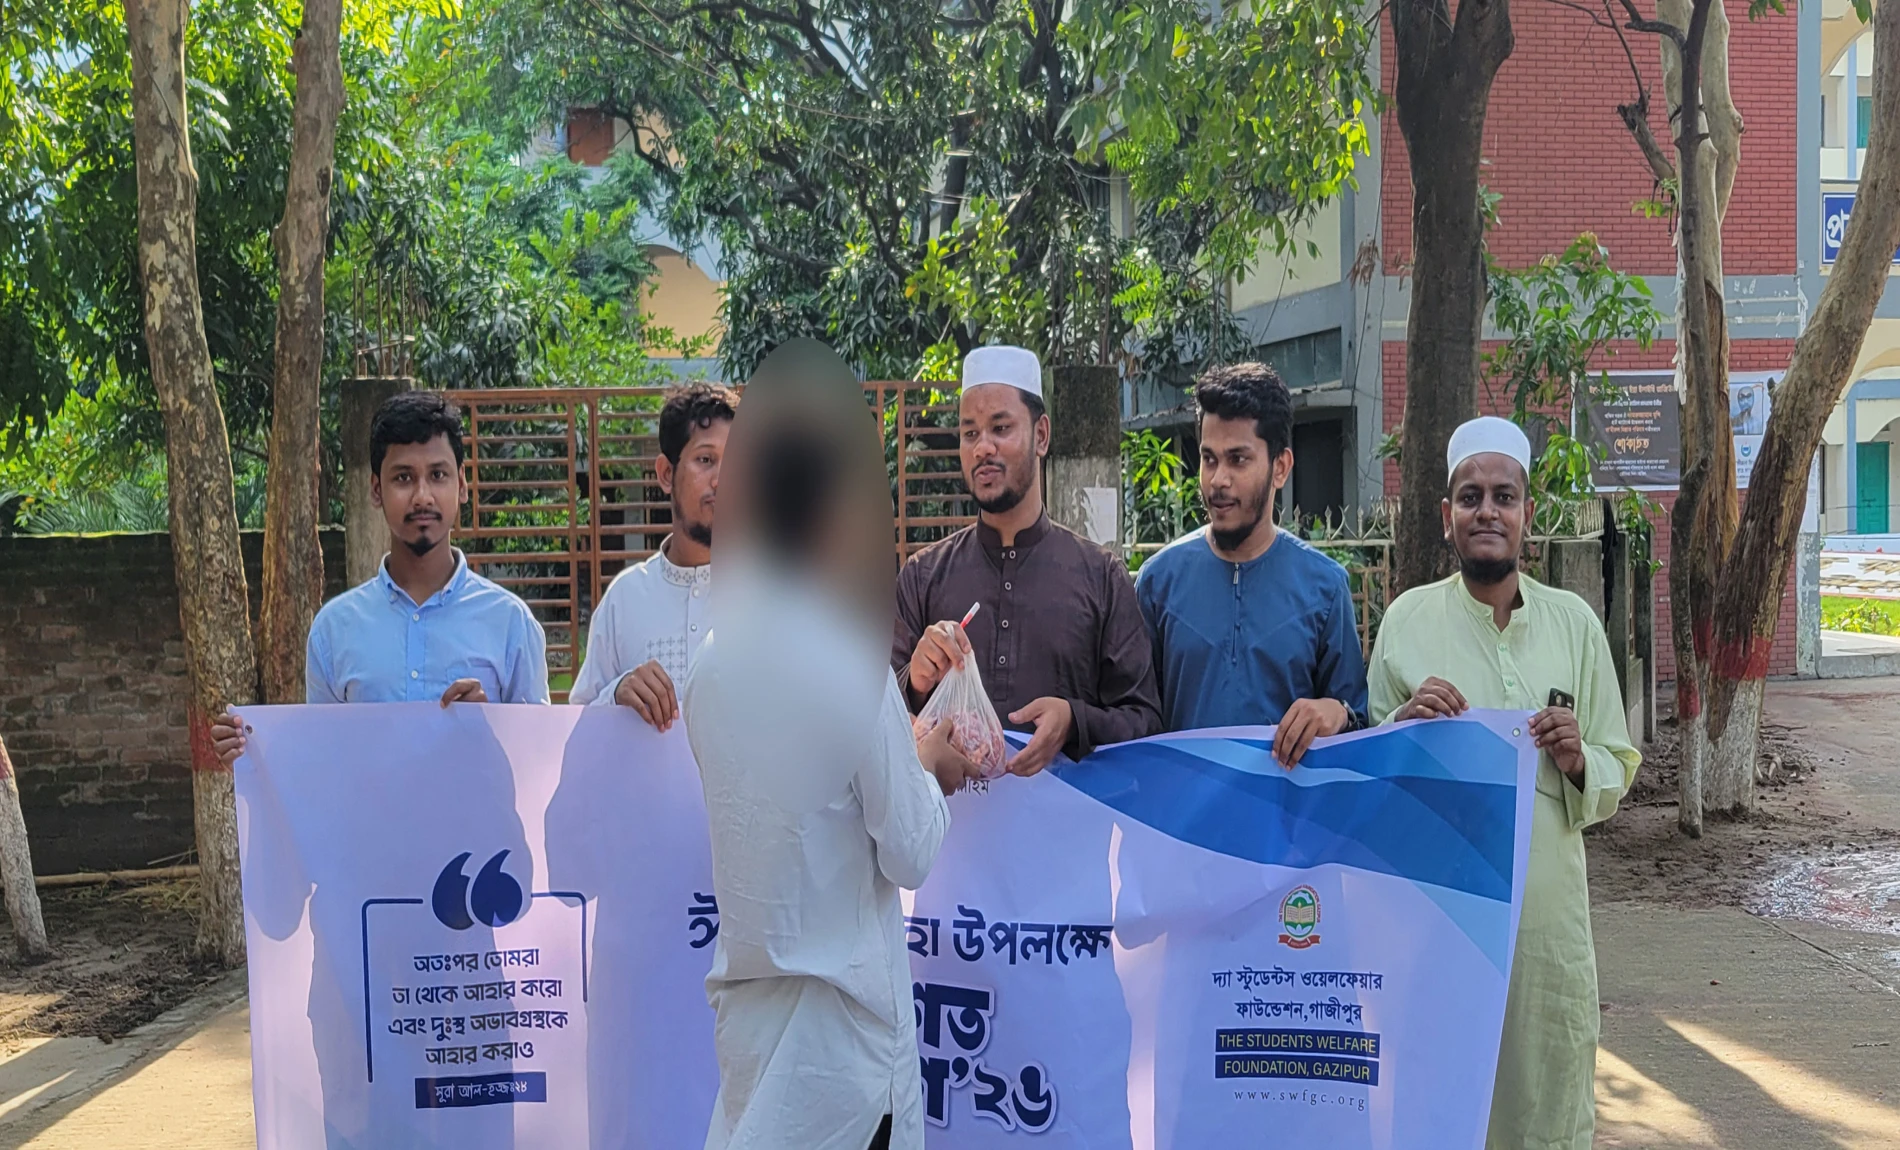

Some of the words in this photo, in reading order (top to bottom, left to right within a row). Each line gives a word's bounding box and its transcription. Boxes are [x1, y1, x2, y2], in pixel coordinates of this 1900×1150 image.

[952, 904, 1114, 966] উপলক্ষে
[414, 953, 478, 972] অতঃপর
[484, 949, 539, 969] তোমরা
[1212, 969, 1232, 988] দ্যা
[1236, 964, 1296, 992] স্টুডেন্টস
[1300, 970, 1383, 990] ওয়েলফেয়ার
[393, 987, 410, 1004] তা
[416, 985, 458, 1004] থেকে
[463, 981, 516, 1001] আহার
[521, 979, 562, 998] করো
[388, 1017, 427, 1035] এবং
[431, 1016, 466, 1042] দুঃস্থ
[425, 1046, 478, 1065] আহার
[482, 1042, 535, 1060] করাও
[1219, 1034, 1244, 1048] THE
[1247, 1034, 1313, 1049] STUDENTS
[1316, 1036, 1377, 1053] WELFARE
[1224, 1060, 1310, 1077] FOUNDATION,
[1313, 1061, 1370, 1080] GAZIPUR
[435, 1083, 455, 1103] সূরা
[1234, 1090, 1365, 1111] www.swfgc.org
